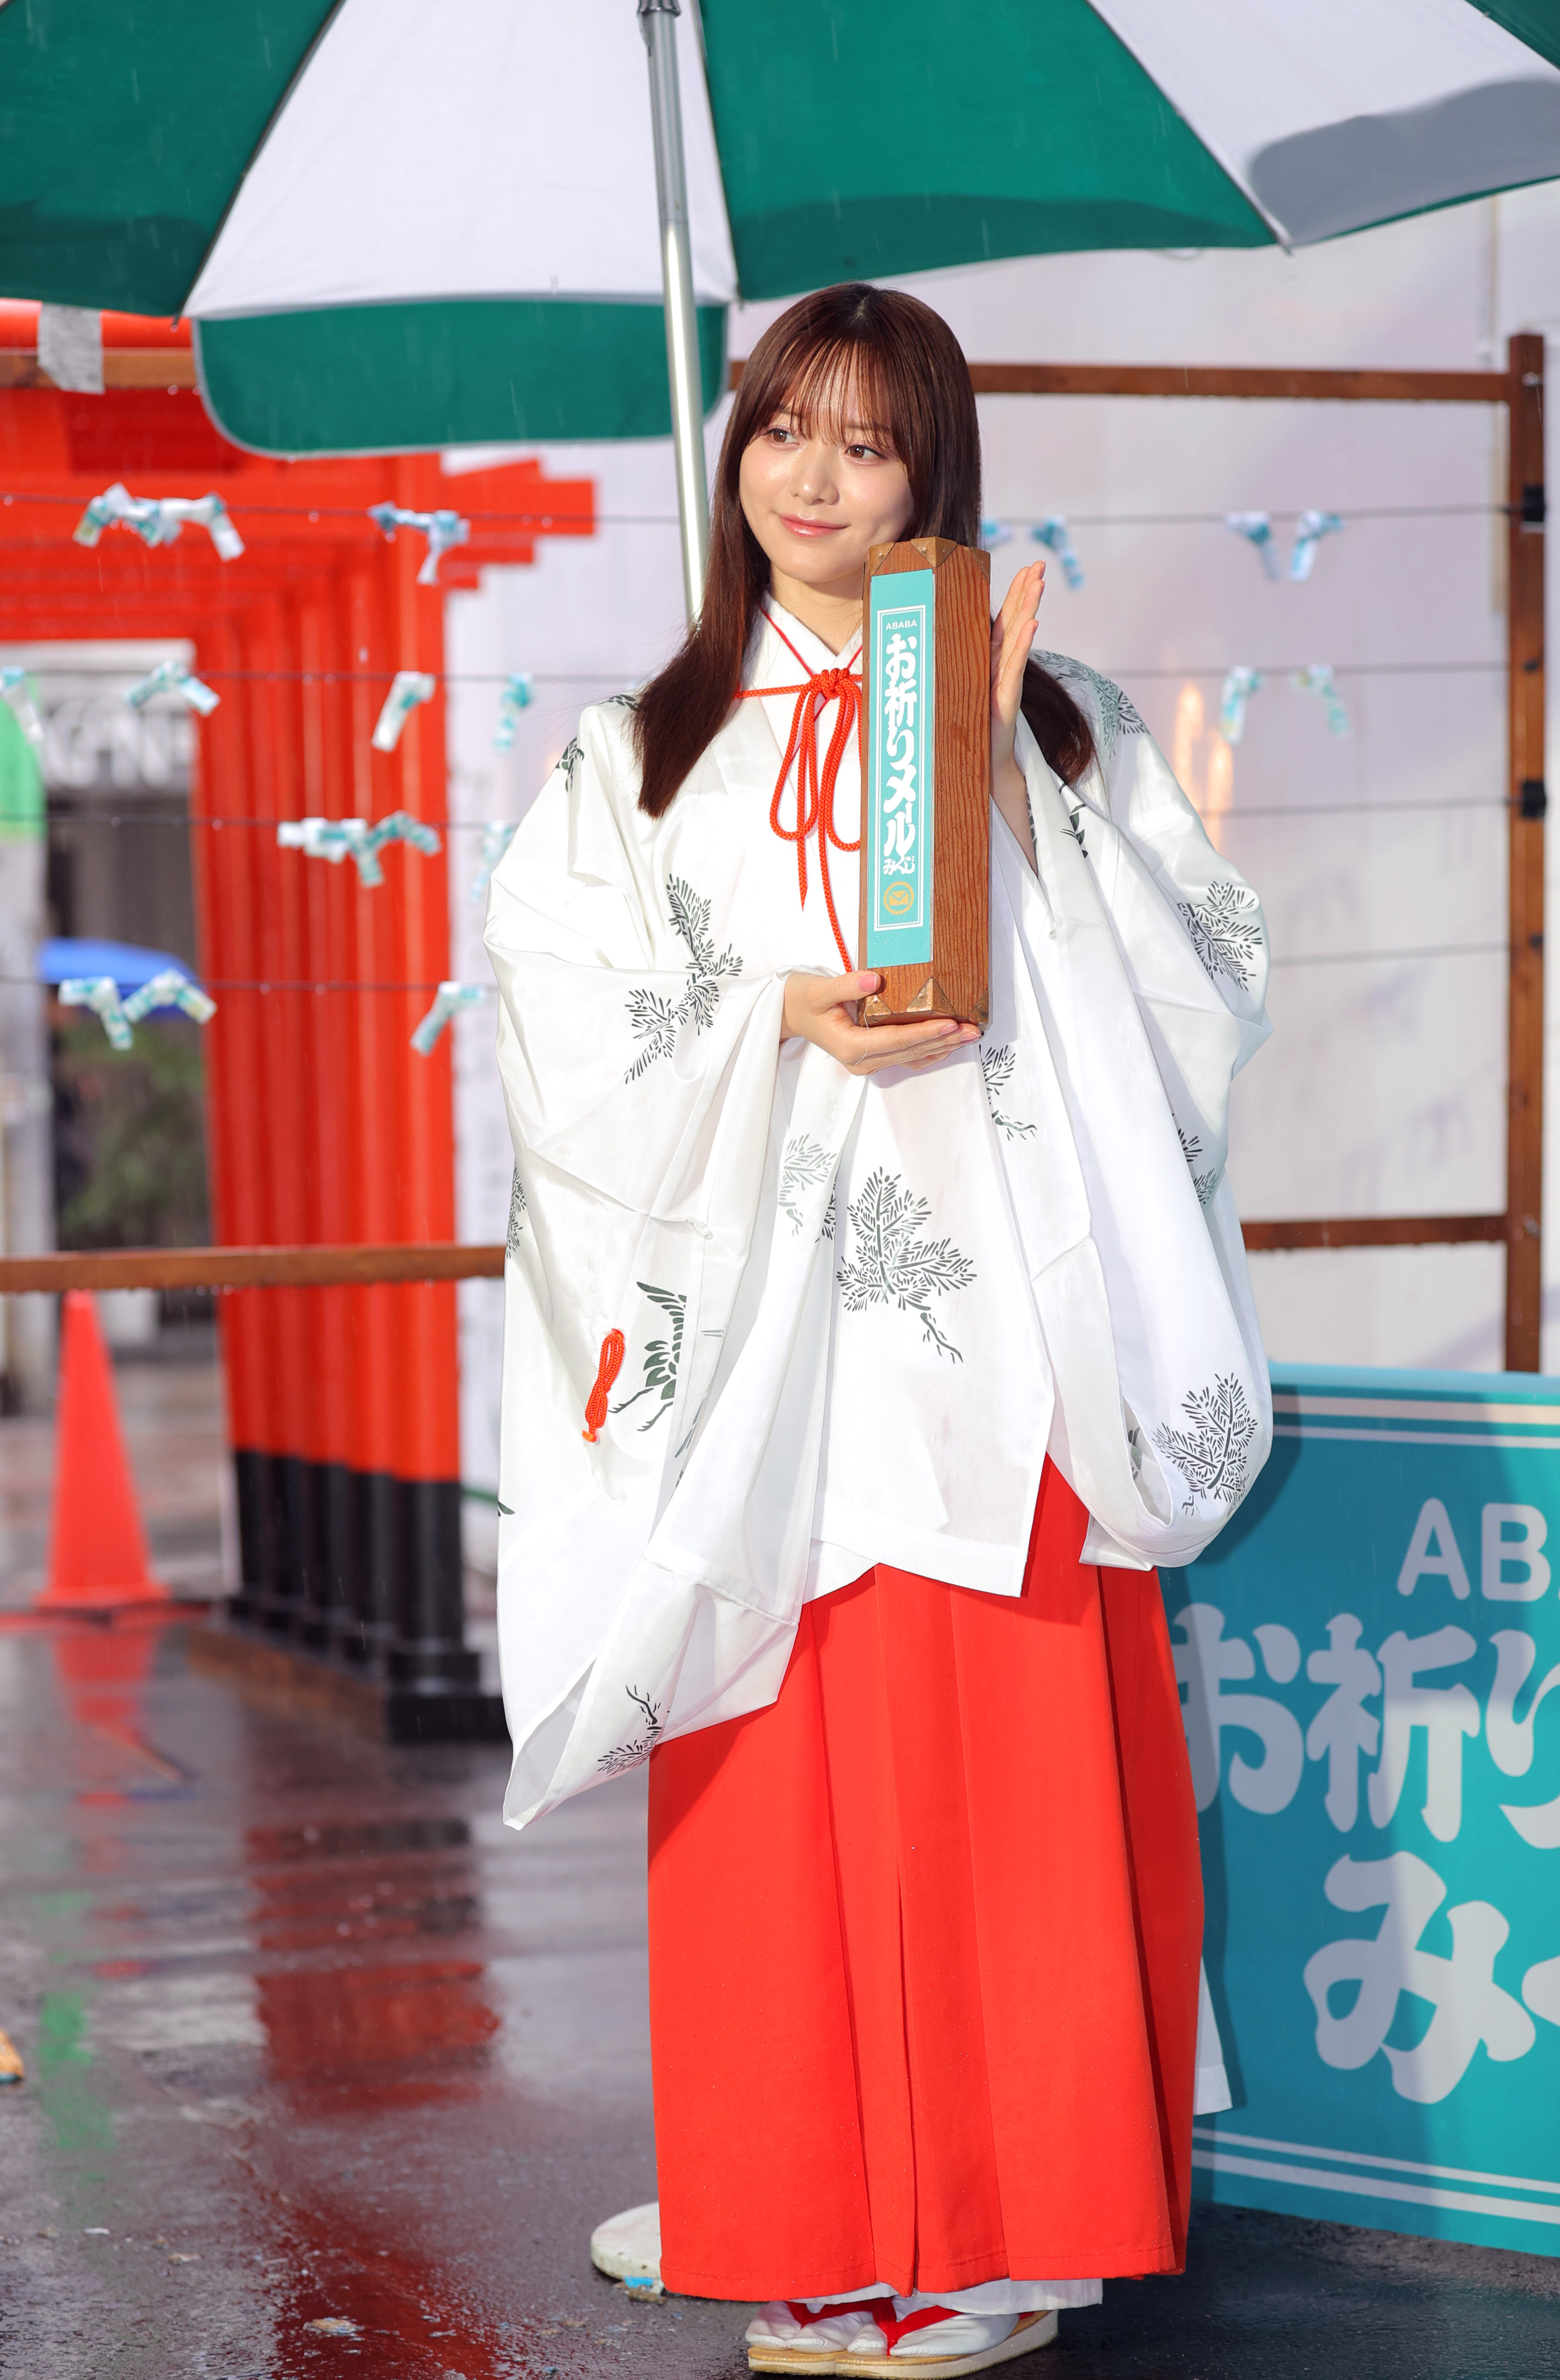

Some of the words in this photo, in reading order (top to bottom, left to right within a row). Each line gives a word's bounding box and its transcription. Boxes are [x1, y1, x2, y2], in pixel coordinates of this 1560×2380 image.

[885, 619, 917, 630] ABABA
[883, 633, 917, 857] お祈りメール
[1397, 1498, 1560, 1602] AB
[1303, 1851, 1560, 2104] み
